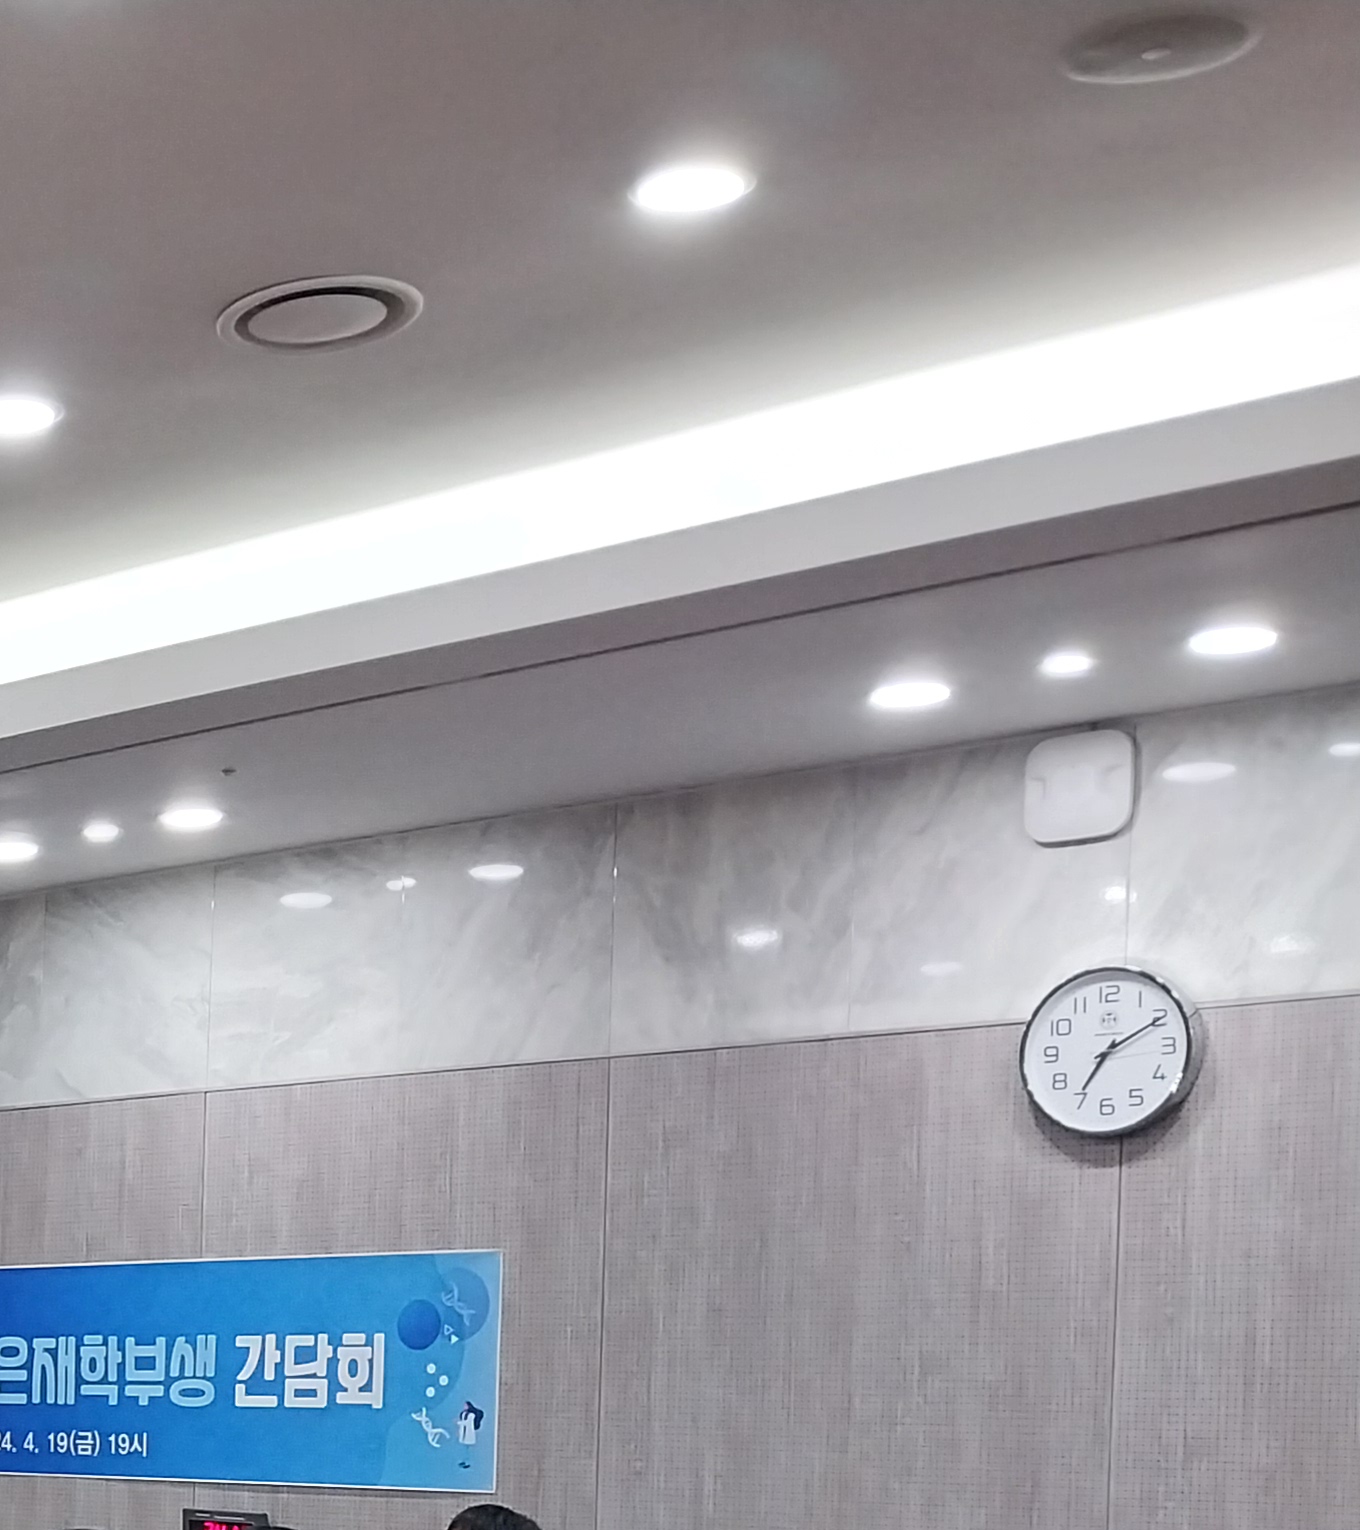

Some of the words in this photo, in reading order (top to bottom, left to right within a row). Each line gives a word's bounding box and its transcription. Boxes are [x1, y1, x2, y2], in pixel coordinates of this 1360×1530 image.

[1098, 984, 1121, 1004] 12
[1137, 990, 1143, 1008] 1
[1073, 996, 1087, 1015] 11
[1152, 1008, 1168, 1027] 2
[1049, 1018, 1072, 1037] 10
[1043, 1045, 1059, 1064] 9
[1160, 1036, 1177, 1055] 3
[1052, 1072, 1068, 1091] 8
[1151, 1063, 1168, 1081] 4
[1073, 1092, 1088, 1110] 7
[1098, 1097, 1116, 1116] 6
[1128, 1087, 1144, 1107] 5
[234, 1333, 385, 1409] 간담회
[23, 1431, 40, 1454] 4.
[47, 1429, 101, 1457] 19(금)
[108, 1432, 149, 1457] 19시
